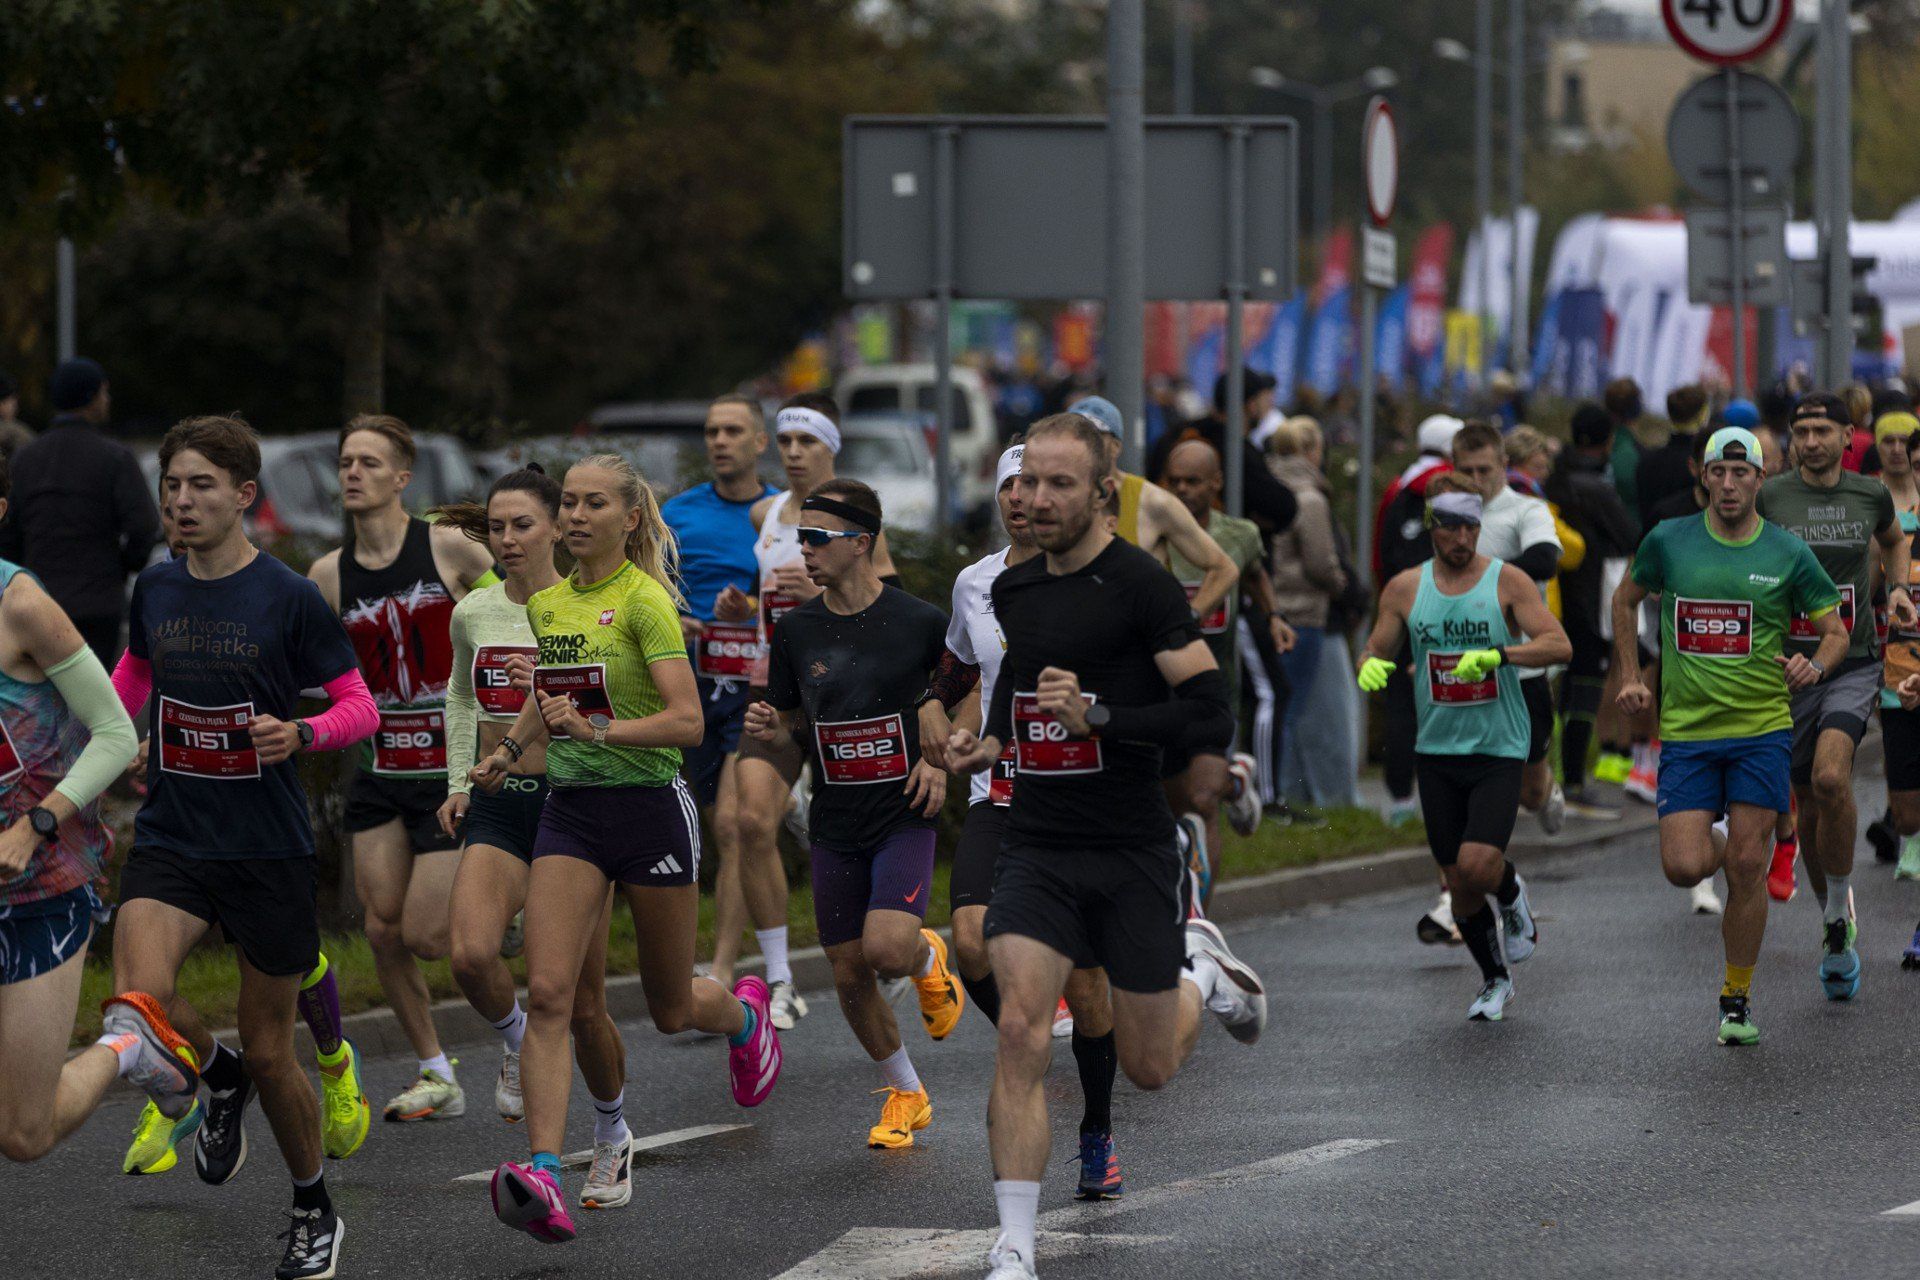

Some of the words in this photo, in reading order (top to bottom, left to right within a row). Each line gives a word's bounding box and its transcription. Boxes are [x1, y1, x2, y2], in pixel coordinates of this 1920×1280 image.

[193, 615, 247, 637] Nocna
[1685, 618, 1741, 635] 1699
[192, 635, 259, 658] Piątka
[180, 728, 229, 750] 1151
[383, 732, 433, 749] 380
[1028, 721, 1068, 742] 80
[829, 738, 893, 760] 1682
[503, 777, 539, 792] RO
